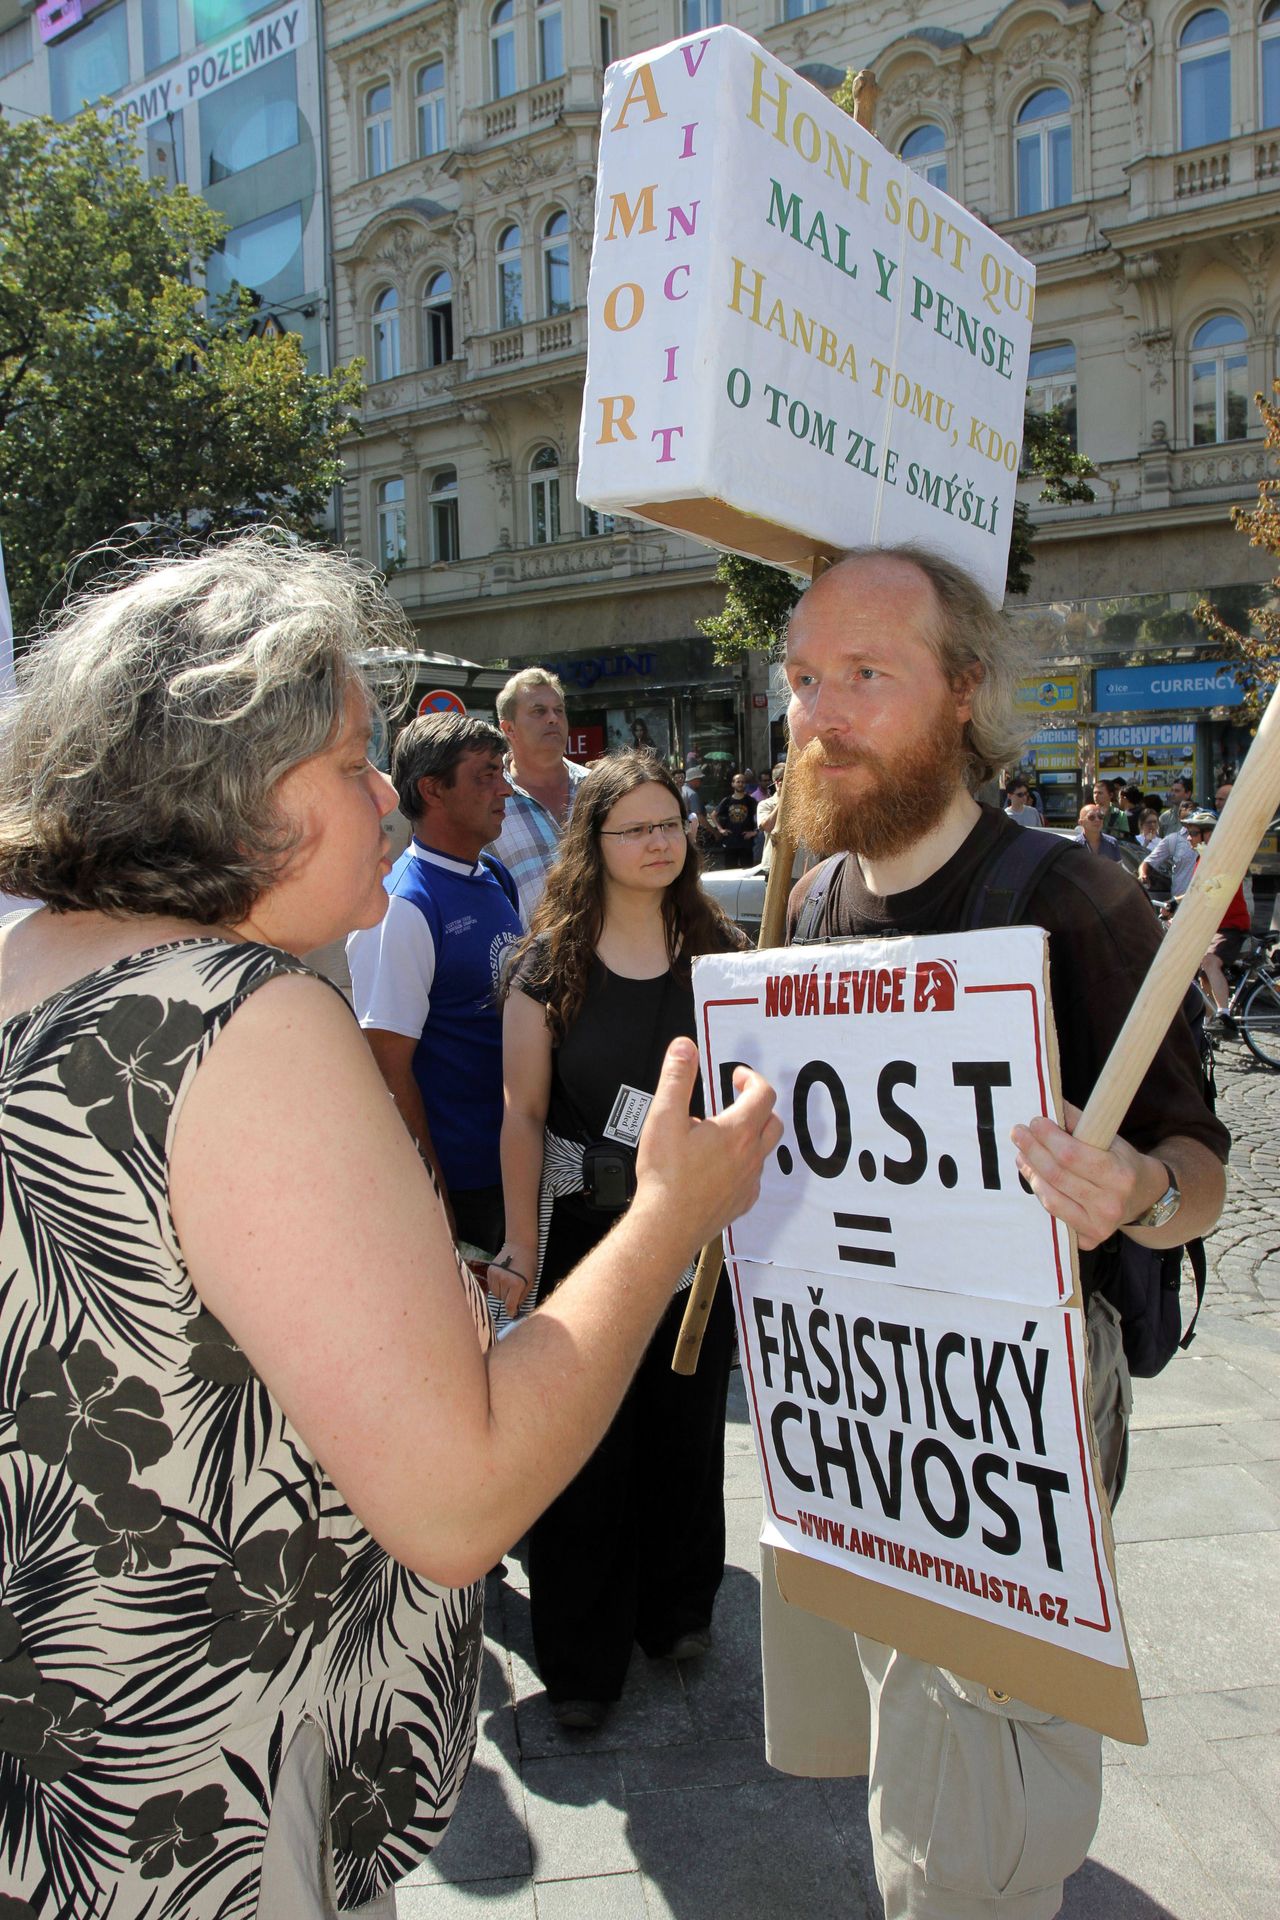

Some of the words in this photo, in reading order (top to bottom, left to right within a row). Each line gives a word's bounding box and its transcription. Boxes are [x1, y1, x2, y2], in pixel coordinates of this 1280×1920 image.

[187, 10, 299, 97] POZEMKY
[746, 51, 873, 206] HONI
[885, 178, 971, 273] SOIT
[981, 252, 1036, 321] QUI
[766, 177, 858, 280] MAL
[872, 249, 898, 303] Y
[911, 275, 1015, 380] PENSE
[727, 256, 859, 383] HANBA
[869, 357, 959, 447] TOMU,
[967, 416, 1018, 473] KDO
[726, 367, 752, 410] O
[764, 383, 837, 456] TOM
[844, 428, 899, 487] ZLE
[906, 462, 1000, 536] SMÝŠLÍ
[564, 734, 588, 755] LE
[1098, 723, 1195, 746] ЭКСКУРСИИ
[1115, 683, 1129, 692] ice
[1150, 676, 1236, 694] CURRENCY
[765, 964, 820, 1018] NOVÁ
[823, 966, 907, 1016] LEVICE
[628, 1096, 648, 1134] Evropský
[752, 1286, 1050, 1457] FAŠISTICKÝ
[770, 1400, 1071, 1573] CHVOST
[796, 1509, 1070, 1628] WWW.ANTIKAPITALISTA.CZ
